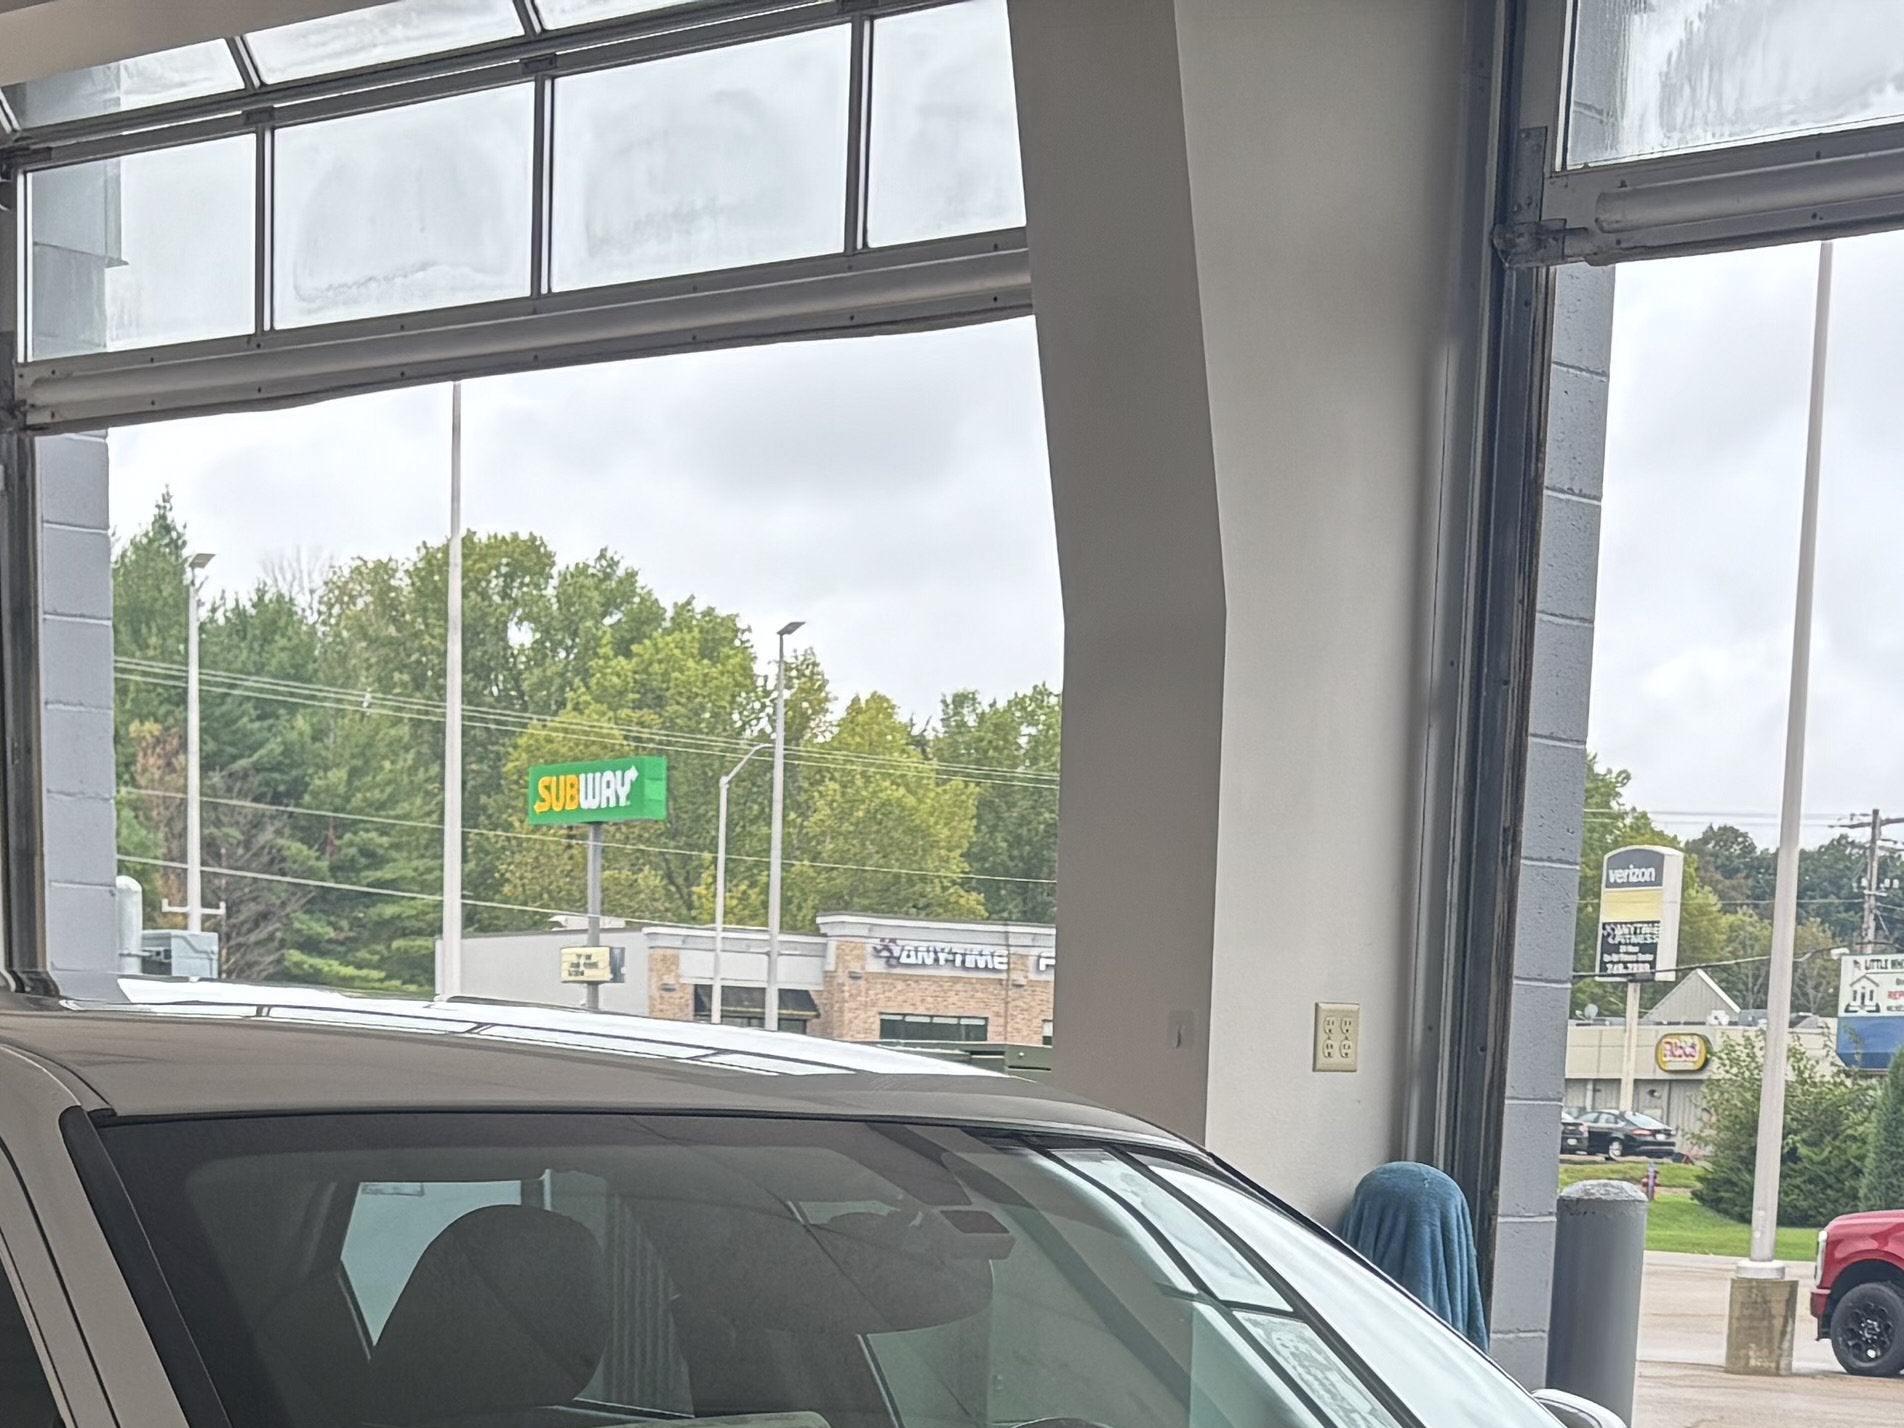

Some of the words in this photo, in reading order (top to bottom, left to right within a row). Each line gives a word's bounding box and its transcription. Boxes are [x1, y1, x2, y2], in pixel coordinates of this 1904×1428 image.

[534, 765, 639, 815] SUBWAY
[1609, 864, 1655, 884] verizon
[899, 944, 1009, 971] ANYTIME
[1864, 959, 1888, 970] LITTLE
